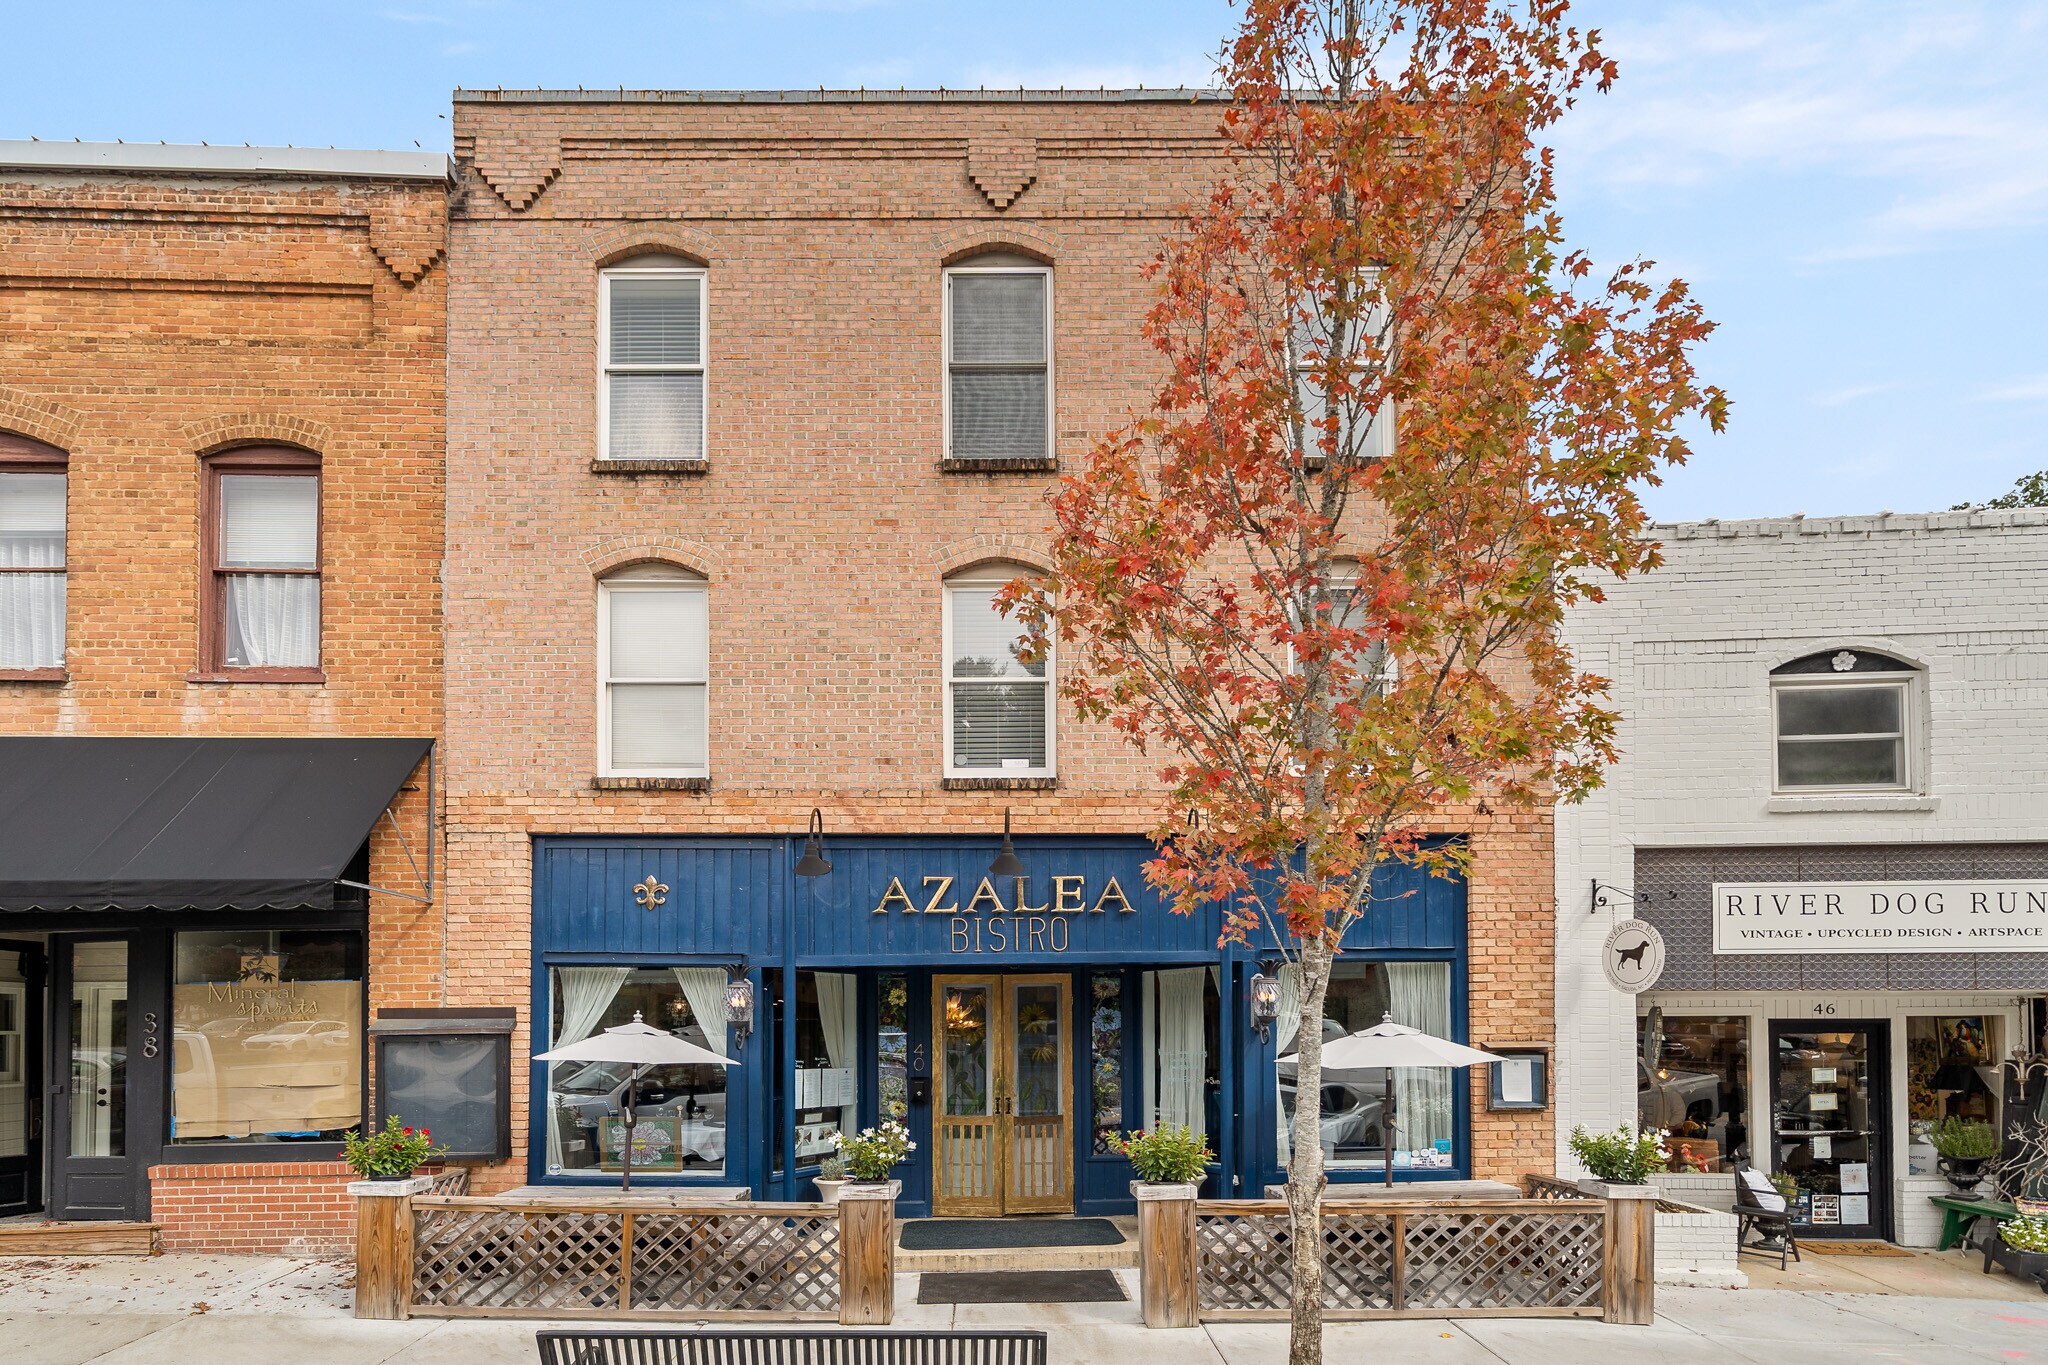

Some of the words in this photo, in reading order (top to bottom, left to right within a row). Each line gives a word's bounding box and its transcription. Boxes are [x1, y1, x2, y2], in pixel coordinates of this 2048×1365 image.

[872, 875, 1137, 914] AZALEA
[1725, 893, 1845, 916] RIVER
[1870, 891, 1945, 915] DOG
[1970, 891, 2048, 914] RUN
[951, 917, 1069, 953] BISTRO
[1605, 925, 1624, 949] RIVER
[1625, 921, 1644, 930] DOG
[1645, 925, 1660, 945] RUN
[1740, 929, 1804, 939] VINTAGE
[1817, 928, 1893, 938] UPCYCLED
[1897, 928, 1953, 938] DESIGN
[1967, 927, 2044, 937] ARTSPACE
[207, 978, 297, 1004] Mineral
[235, 999, 319, 1023] spirits
[1813, 1003, 1836, 1015] 46
